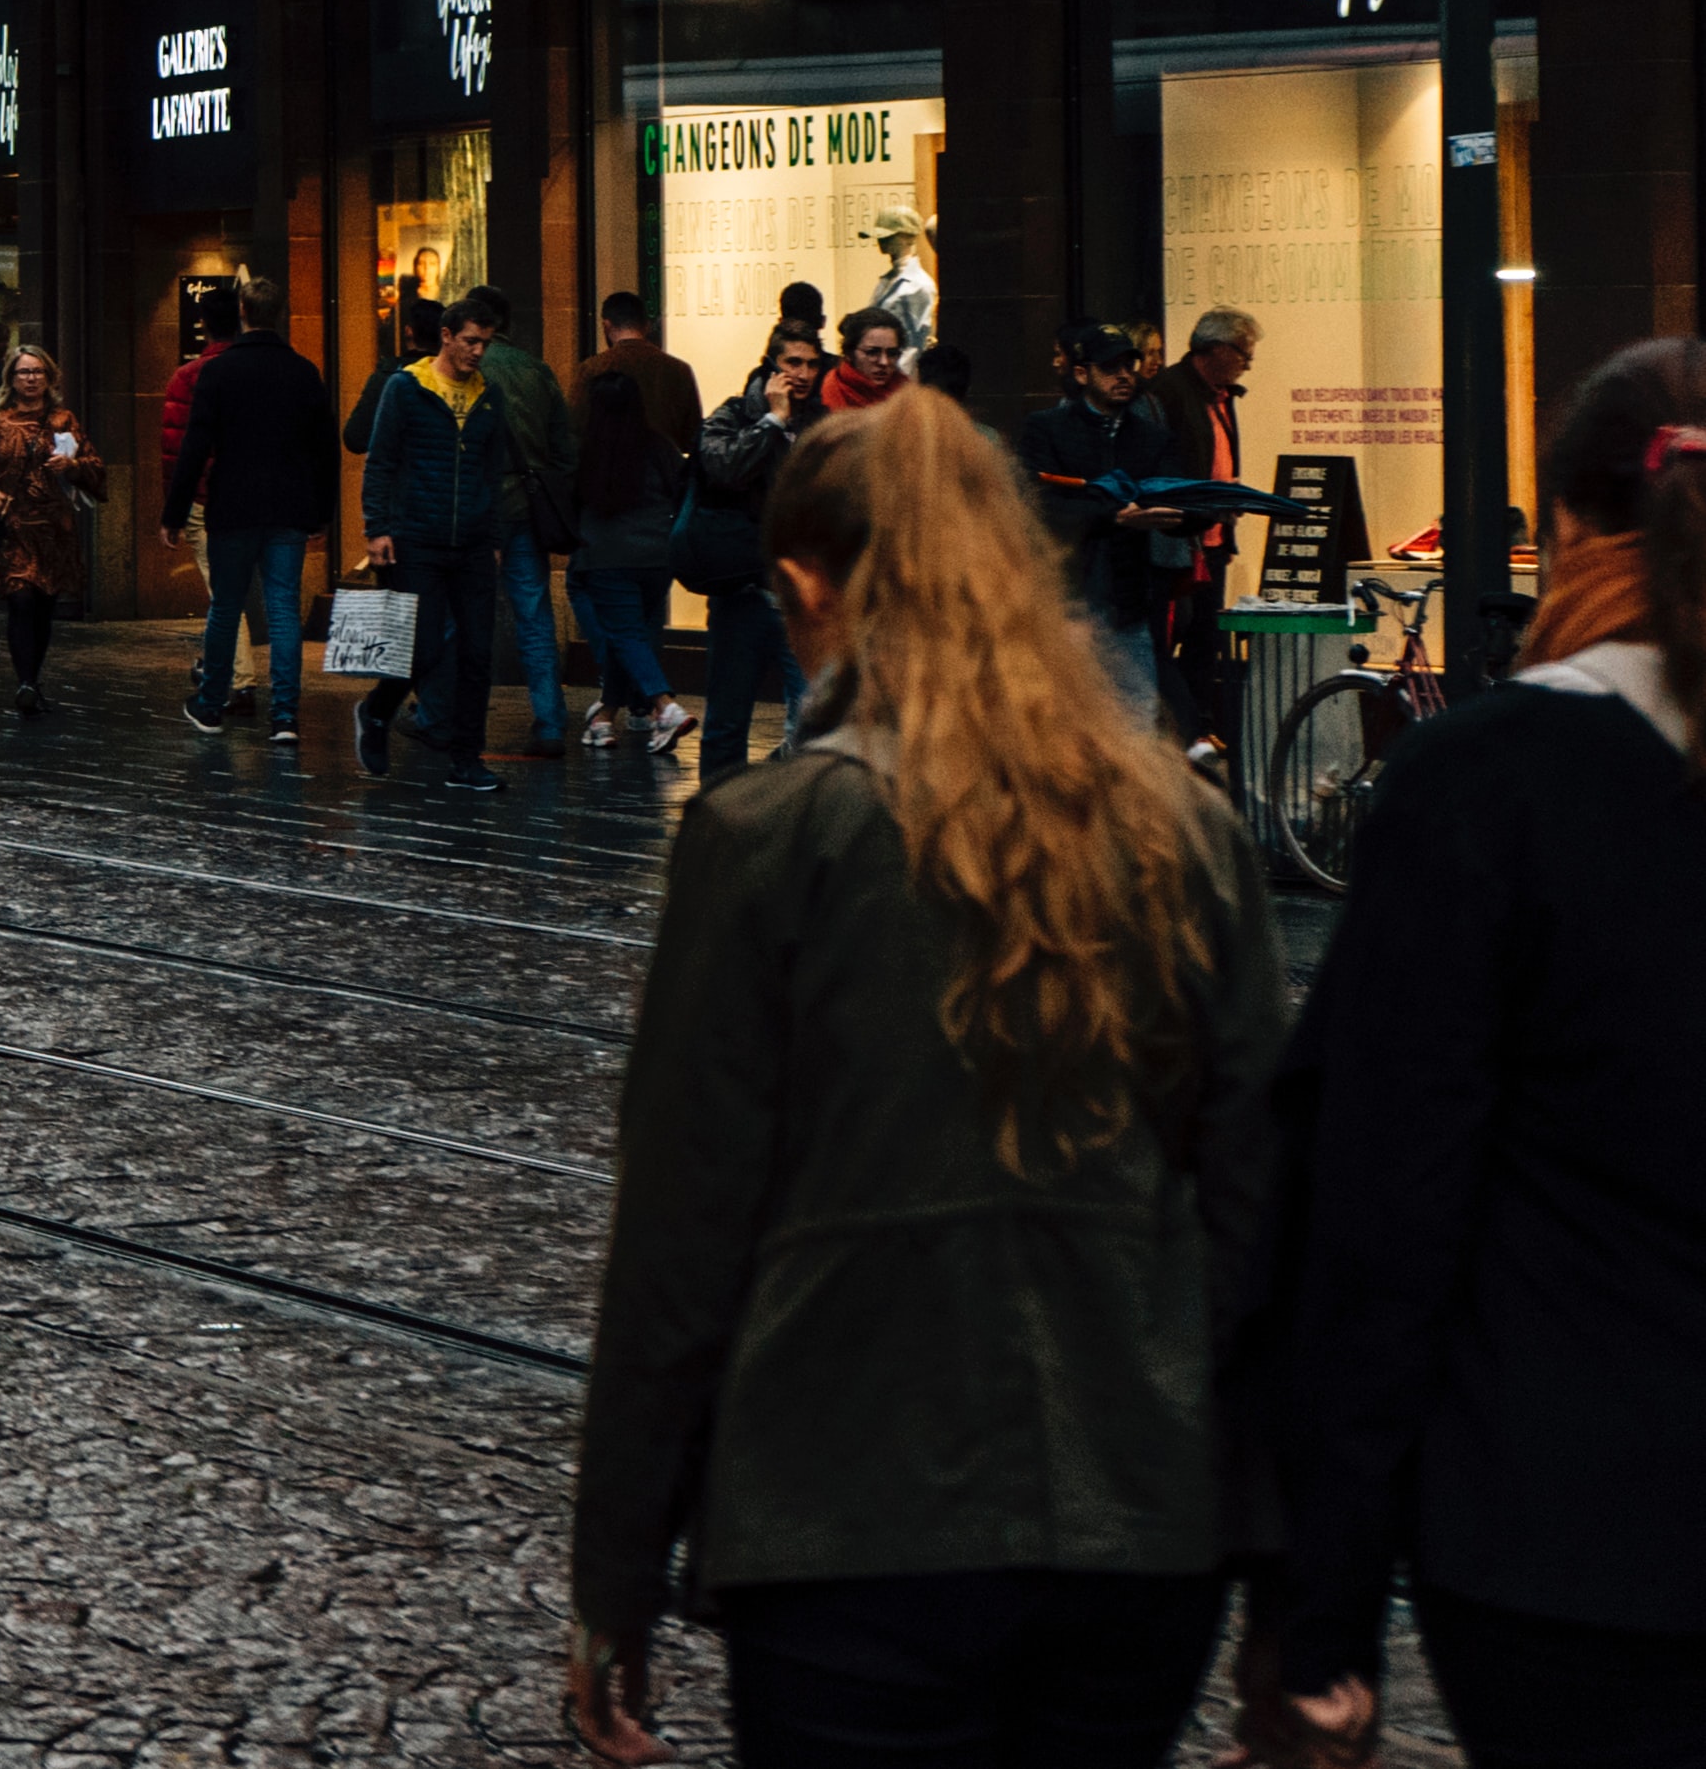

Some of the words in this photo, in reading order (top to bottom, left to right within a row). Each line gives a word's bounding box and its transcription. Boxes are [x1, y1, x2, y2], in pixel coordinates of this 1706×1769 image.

[156, 24, 228, 81] GALERIES
[151, 86, 232, 141] LAFAYETTE
[644, 117, 776, 176] CHANGEONS
[788, 115, 815, 168] DE
[828, 110, 891, 165] MODE
[645, 197, 777, 257] CHANGEONS
[788, 195, 815, 251] DE
[1164, 169, 1330, 235] CHANGEONS
[1344, 166, 1381, 227] DE
[697, 264, 724, 317] LA
[1164, 246, 1196, 306] DE
